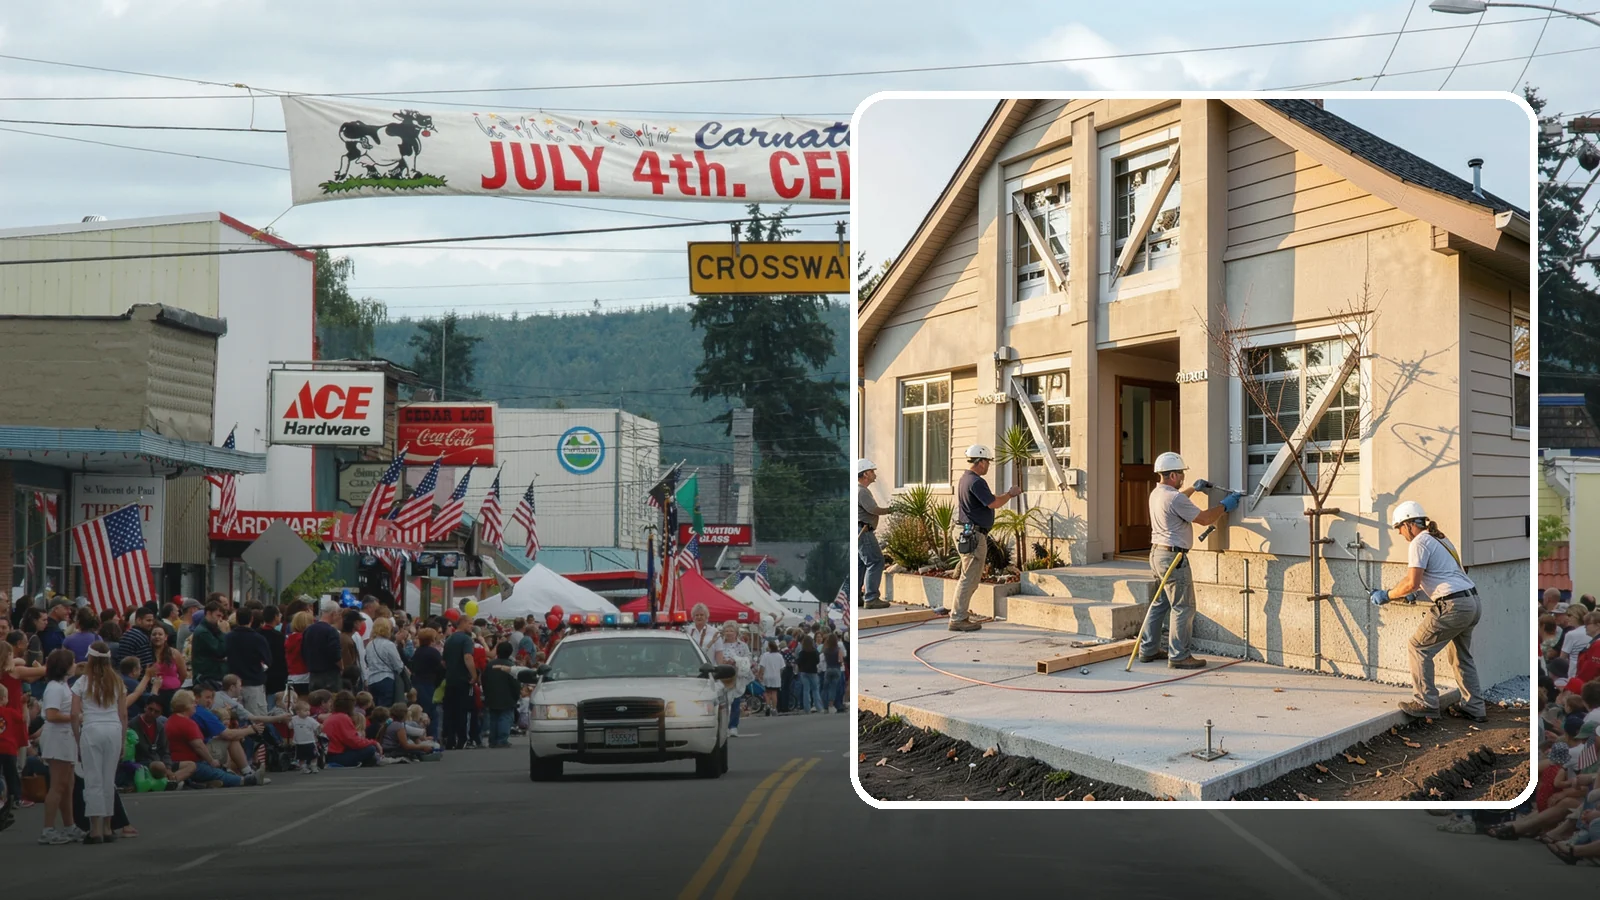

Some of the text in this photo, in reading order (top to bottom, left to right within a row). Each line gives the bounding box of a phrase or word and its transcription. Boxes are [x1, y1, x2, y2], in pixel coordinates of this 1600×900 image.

[695, 121, 850, 149] Carnat
[481, 141, 604, 192] JULY
[632, 150, 746, 197] 4th.
[697, 254, 850, 279] CROSSWA
[283, 380, 373, 419] ACE
[405, 409, 485, 421] CEDAR LOG
[283, 421, 370, 436] Hardware
[416, 428, 476, 447] Coca-Cola
[95, 485, 124, 494] Vincent
[126, 486, 135, 494] de
[137, 486, 155, 495] Paul
[688, 527, 741, 535] CRNATION
[699, 535, 730, 543] GLASS
